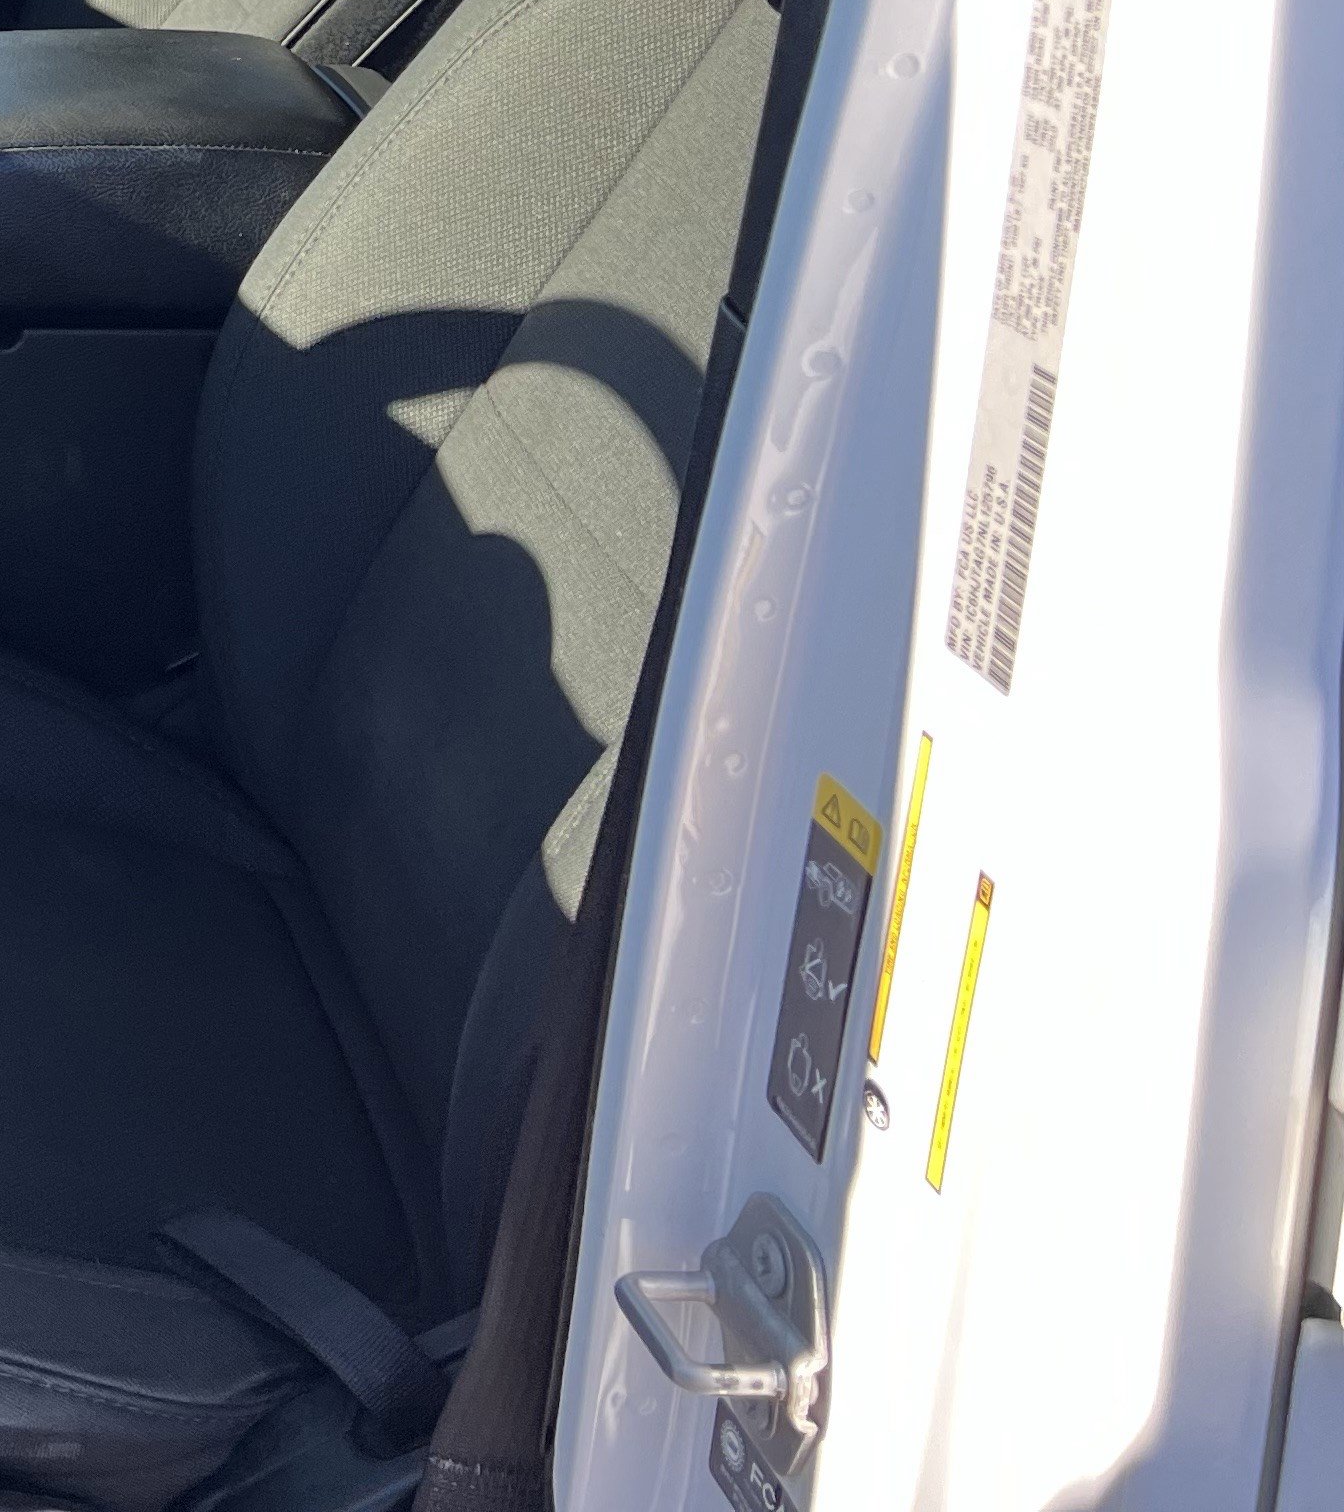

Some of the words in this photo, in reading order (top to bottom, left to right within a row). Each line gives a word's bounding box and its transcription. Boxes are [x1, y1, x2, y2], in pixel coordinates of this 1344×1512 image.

[965, 489, 979, 519] LLC
[961, 521, 974, 545] US
[957, 549, 969, 580] FCA
[972, 607, 991, 670] VEHICLE
[982, 556, 998, 603] MADE
